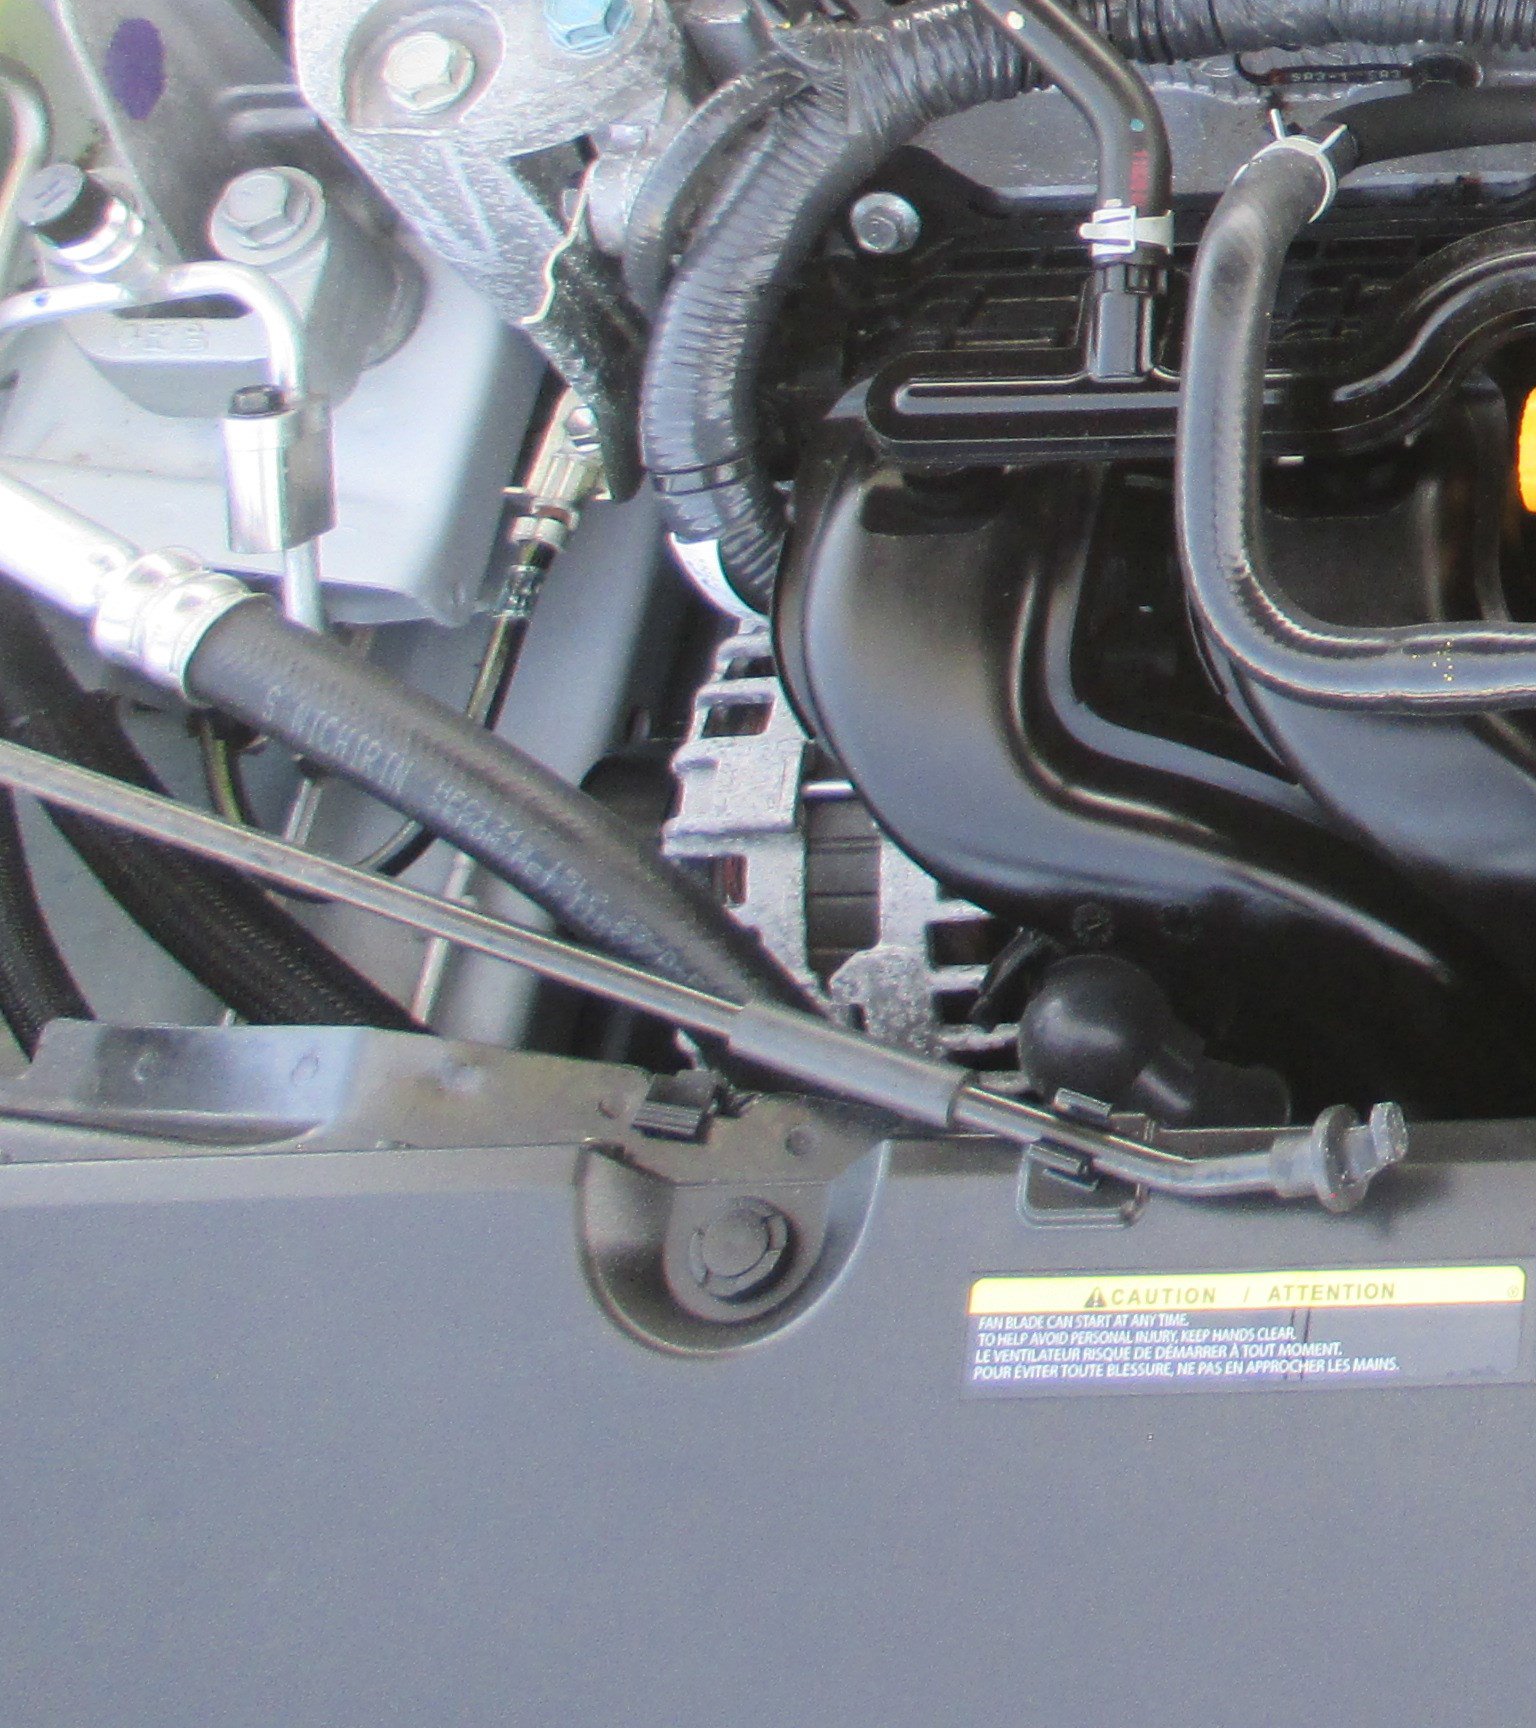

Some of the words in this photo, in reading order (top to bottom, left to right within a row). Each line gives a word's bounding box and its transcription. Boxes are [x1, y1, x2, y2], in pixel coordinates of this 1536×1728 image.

[1111, 1287, 1216, 1306] CAUTION
[1267, 1283, 1395, 1302] ATTENTION
[978, 1316, 1006, 1330] FAN
[1006, 1315, 1045, 1329] BLADE
[1046, 1314, 1074, 1328] CAN
[1075, 1314, 1111, 1328] START
[1112, 1314, 1131, 1327] AT
[1132, 1313, 1159, 1327] ANY
[1159, 1313, 1189, 1327] TIME.
[978, 1333, 995, 1346] TO
[997, 1332, 1028, 1346] HELP
[1029, 1331, 1068, 1345] AVOID
[1070, 1330, 1133, 1345] PERSONAL
[1135, 1329, 1178, 1345] INJURY,
[1180, 1328, 1210, 1343] KEEP
[1212, 1327, 1255, 1341] HANDS
[1257, 1326, 1297, 1341] CLEAR.
[975, 1349, 991, 1364] LE
[993, 1347, 1081, 1363] VENTILATEUR
[1083, 1347, 1131, 1362] RISQUE
[1134, 1346, 1151, 1360] DE
[1154, 1343, 1227, 1360] DÉMARRER
[1243, 1343, 1275, 1358] TOUT
[1278, 1341, 1343, 1357] MOMENT.
[973, 1365, 1011, 1380] POUR
[1013, 1362, 1060, 1379] ÉVITER
[1061, 1363, 1104, 1378] TOUTE
[1106, 1361, 1175, 1378] BLESSURE,
[1177, 1361, 1195, 1375] NE
[1197, 1360, 1222, 1375] PAS
[1225, 1359, 1243, 1373] EN
[1245, 1357, 1326, 1373] APPROCHER
[1327, 1357, 1351, 1372] LES
[1353, 1356, 1400, 1371] MAINS.
